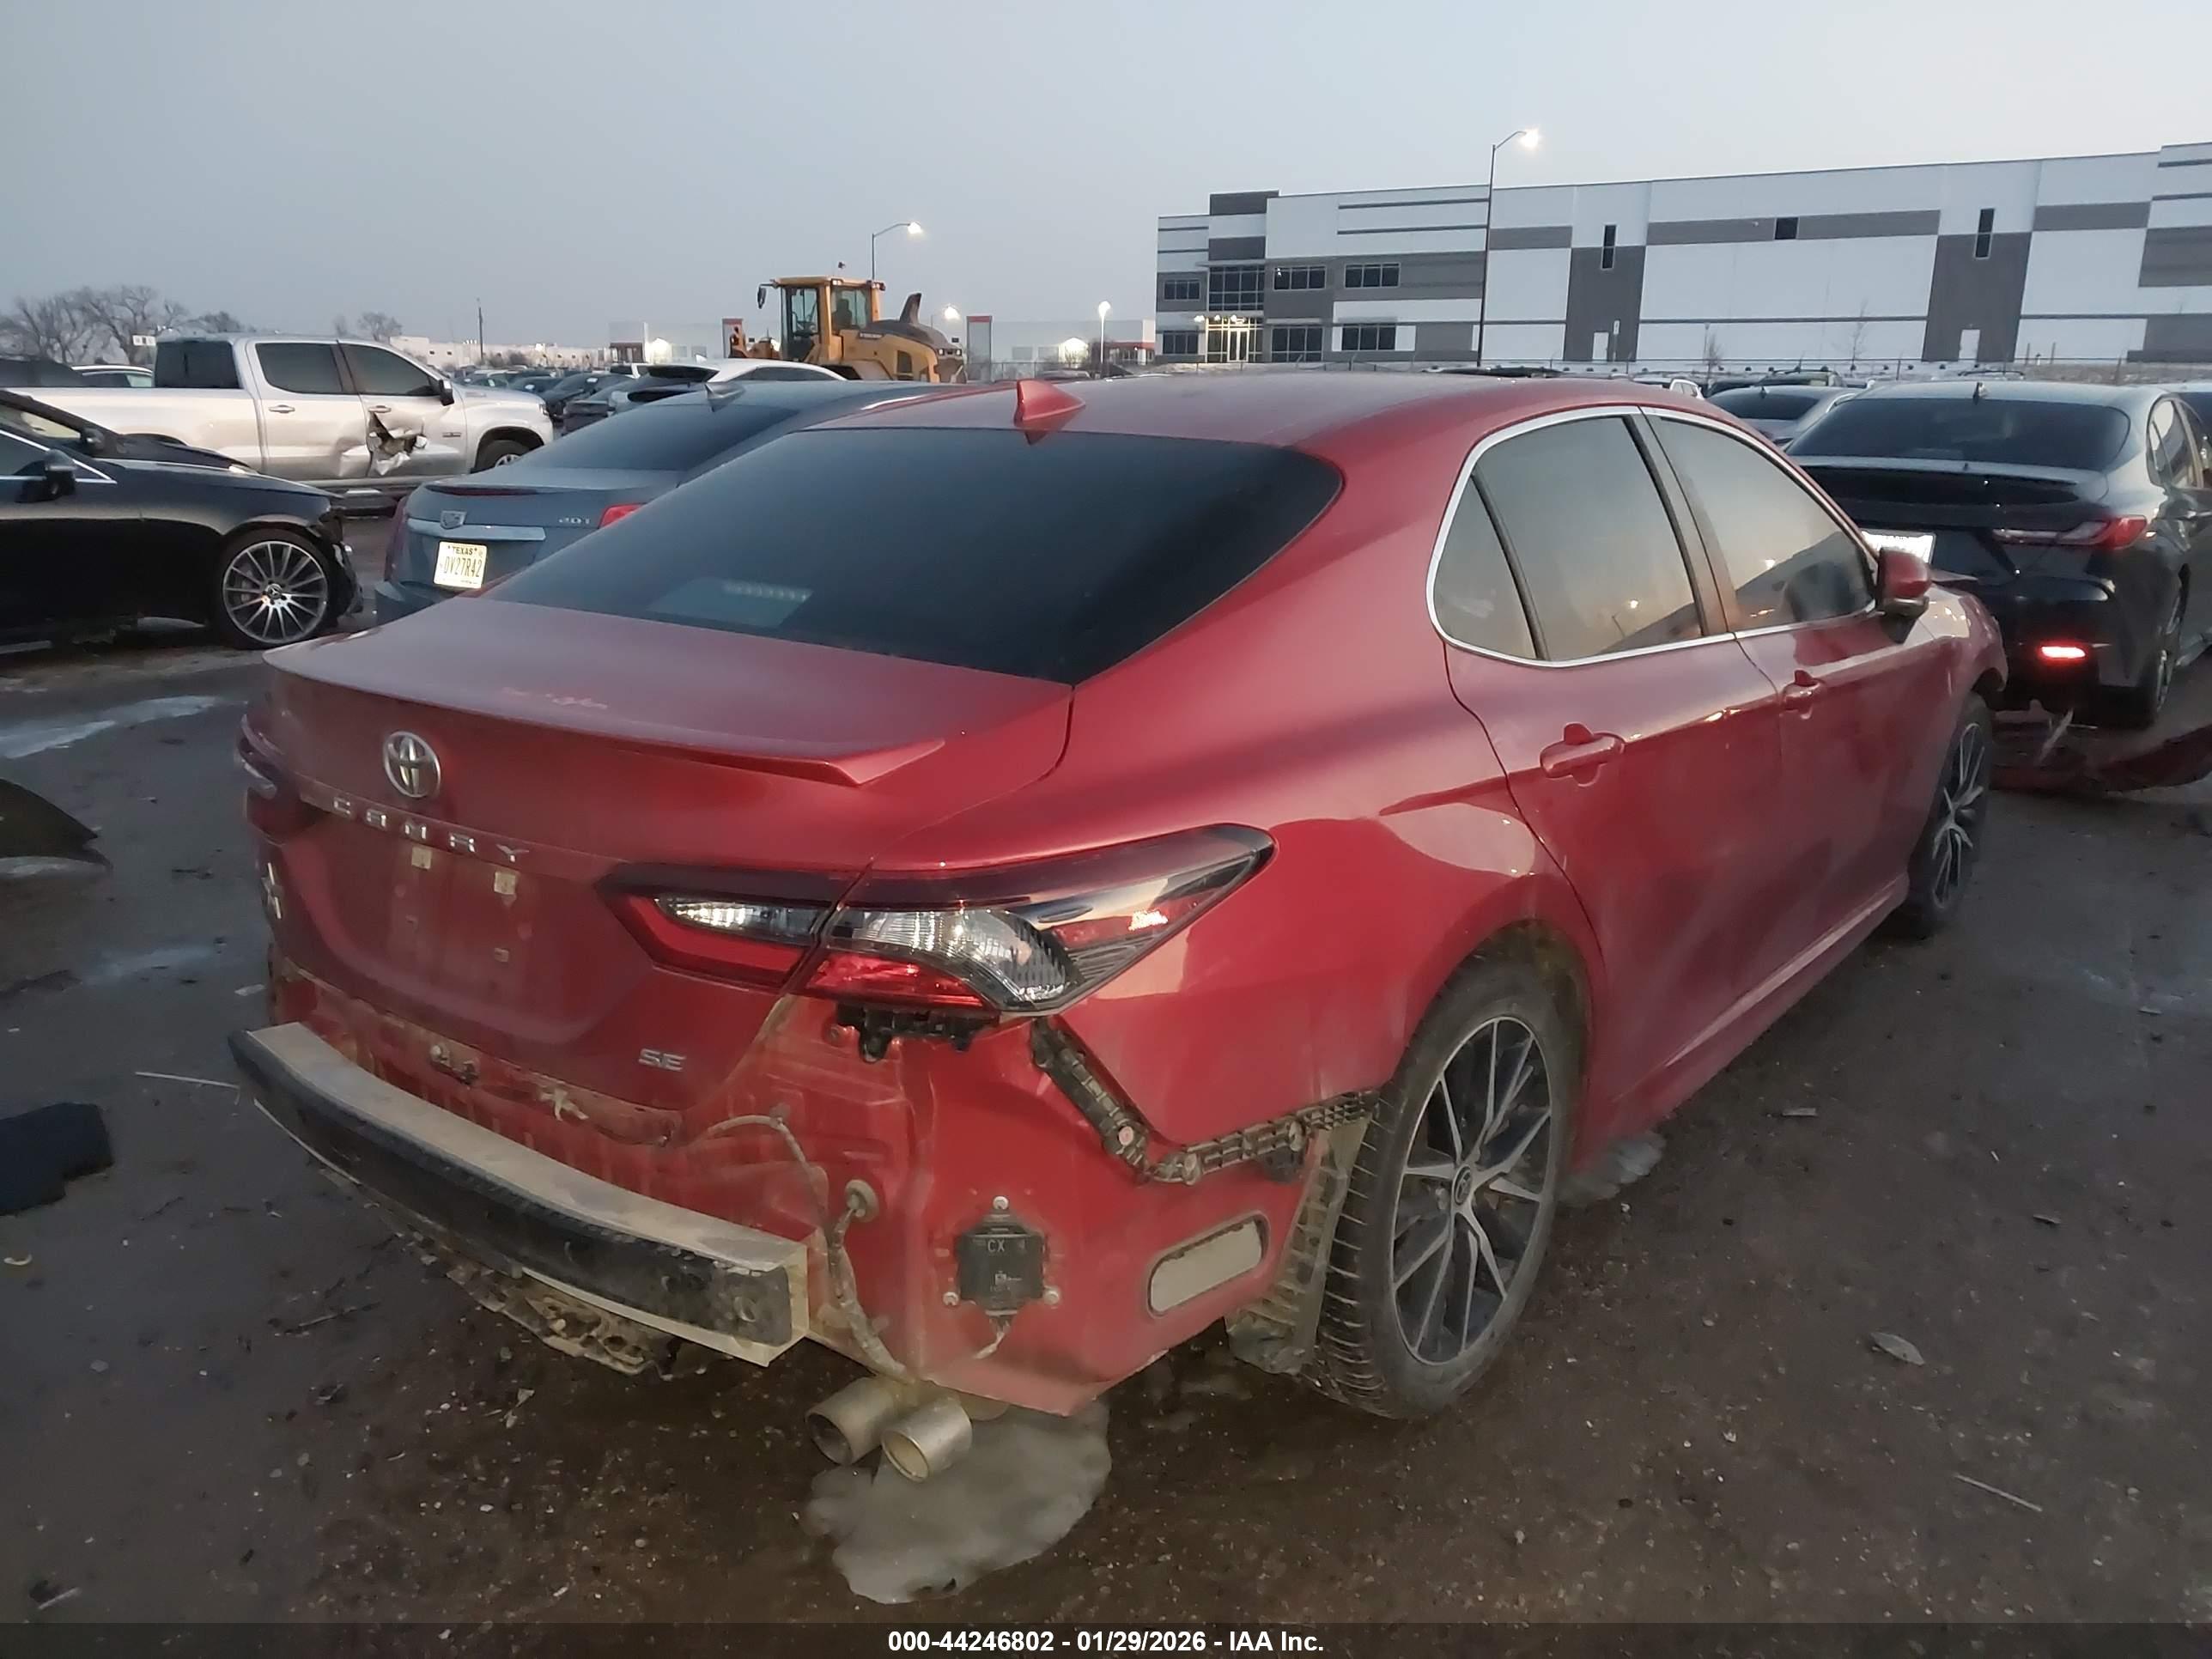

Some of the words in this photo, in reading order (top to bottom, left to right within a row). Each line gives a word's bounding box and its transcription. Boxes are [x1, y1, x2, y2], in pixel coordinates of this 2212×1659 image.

[453, 546, 473, 556] TEXAS
[332, 797, 530, 863] CAMRY
[637, 1048, 687, 1072] SE
[987, 1239, 1006, 1253] CX
